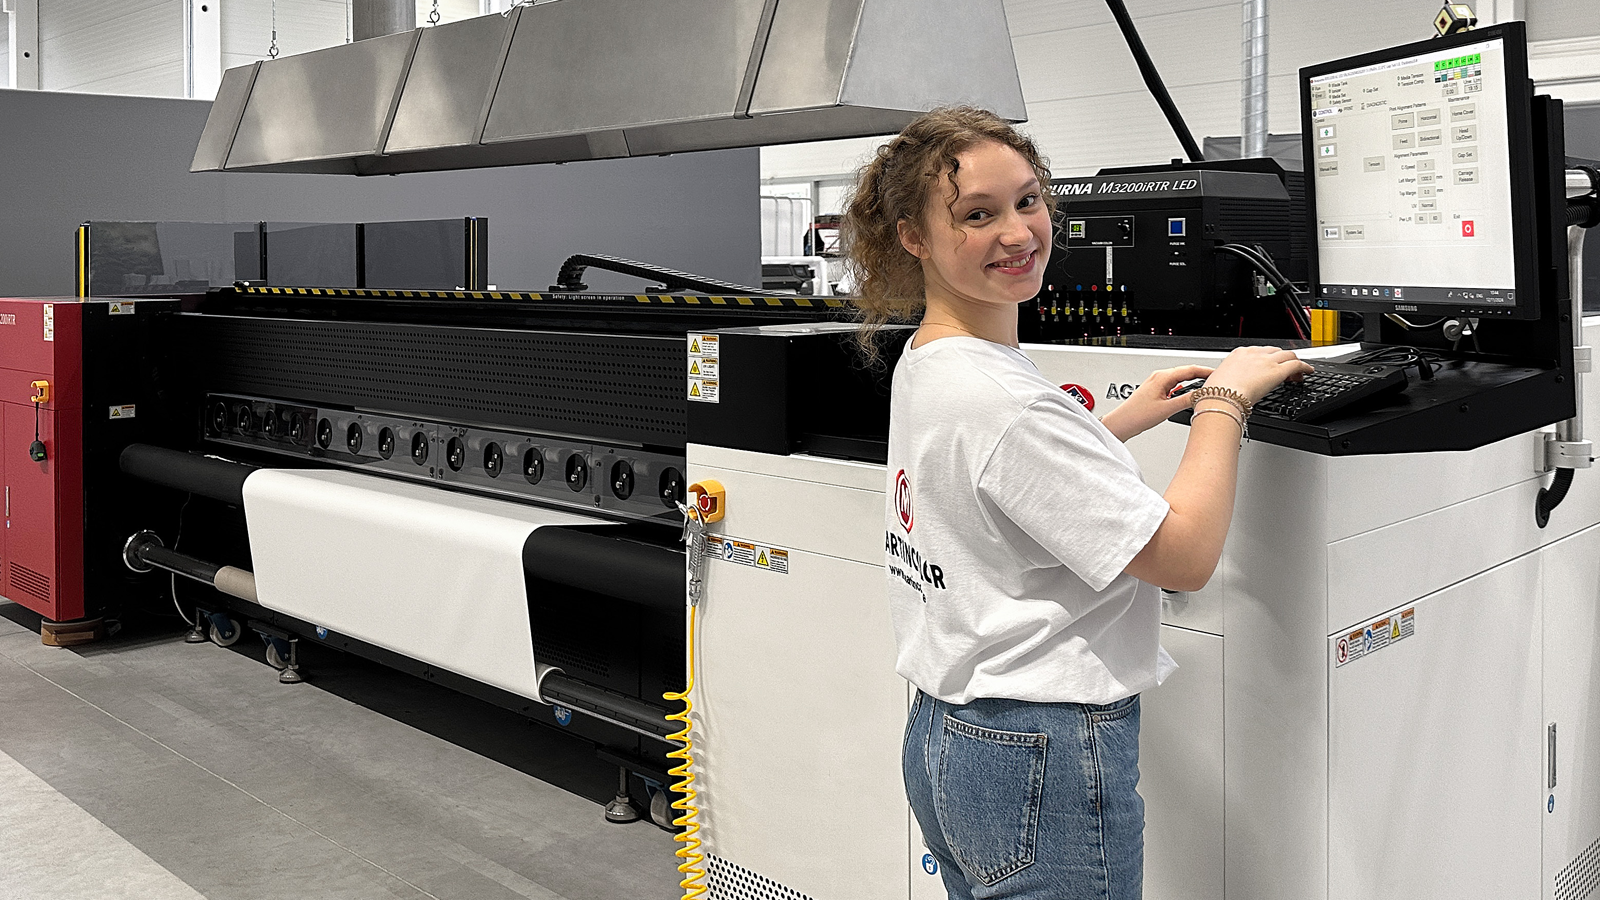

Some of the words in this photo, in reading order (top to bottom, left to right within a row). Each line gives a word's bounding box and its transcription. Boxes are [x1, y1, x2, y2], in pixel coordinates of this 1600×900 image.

[1049, 183, 1092, 196] URNA
[1098, 181, 1170, 194] M3200iRTR
[1172, 180, 1198, 190] LED
[1106, 383, 1140, 400] AG
